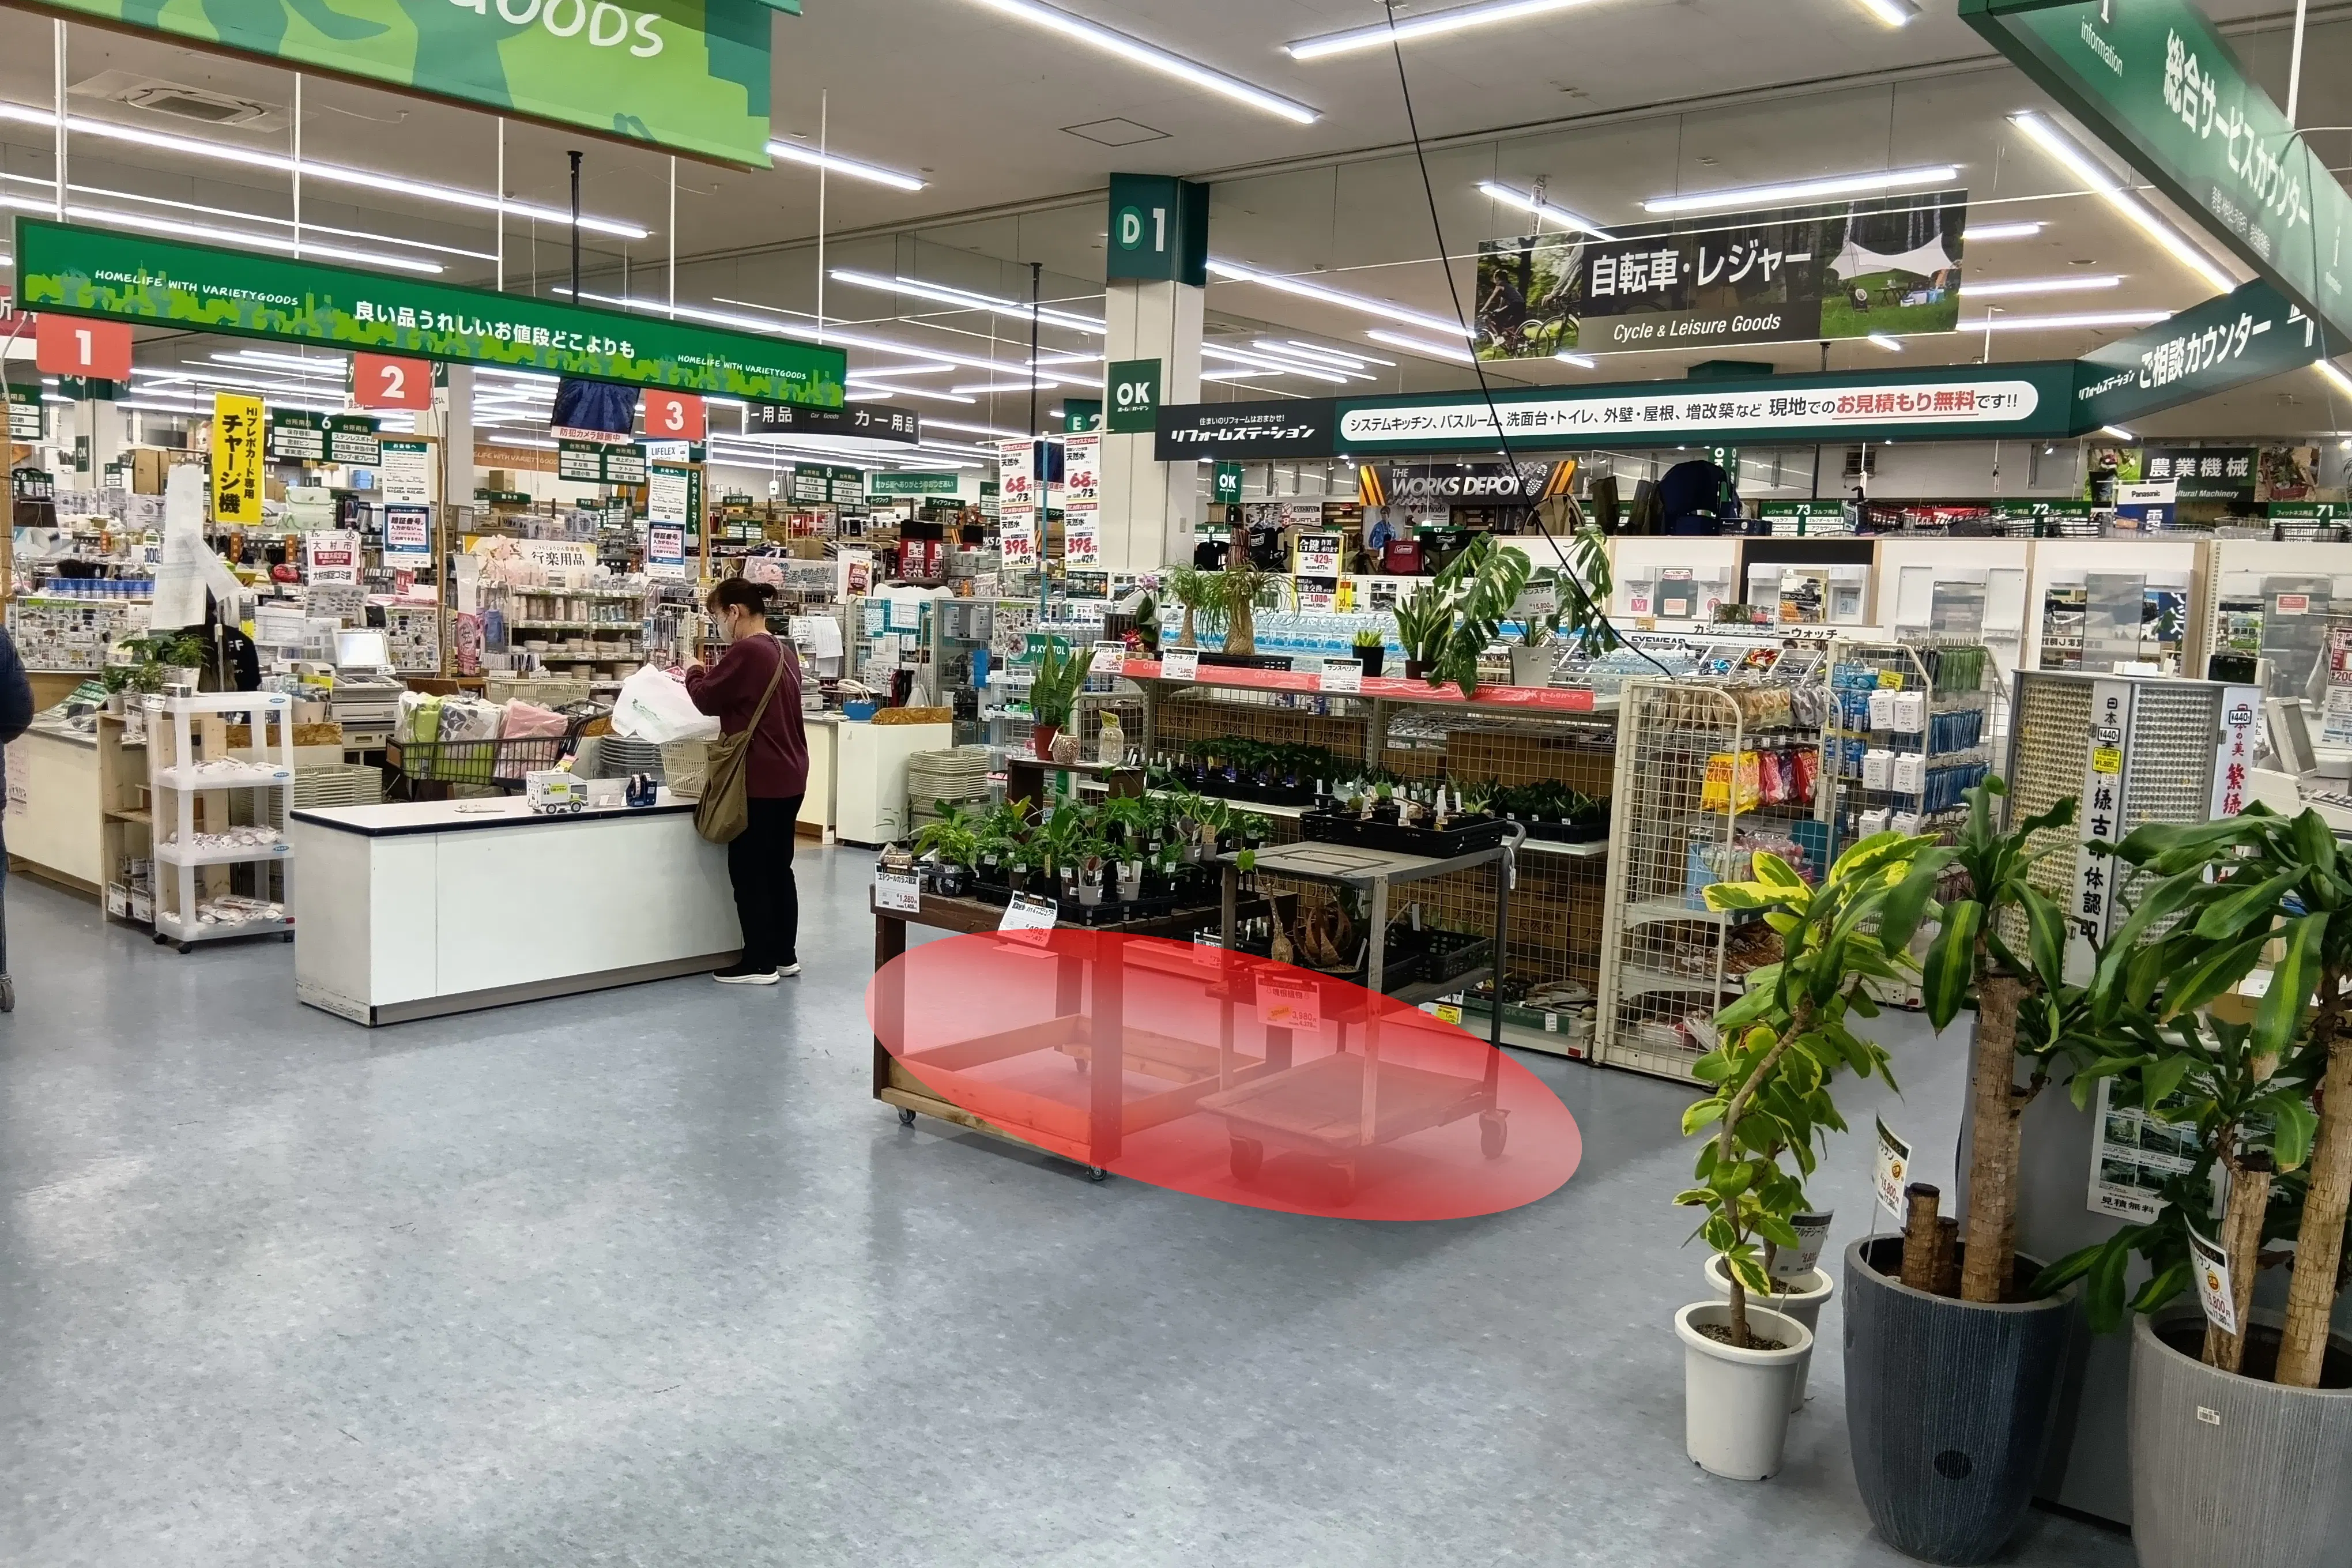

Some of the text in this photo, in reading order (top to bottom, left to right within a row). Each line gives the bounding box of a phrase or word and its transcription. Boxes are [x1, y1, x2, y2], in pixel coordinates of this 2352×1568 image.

[448, 0, 664, 58] OODS
[2081, 15, 2123, 77] information
[2163, 27, 2310, 229] 総合サービスカウンター
[1122, 208, 1165, 252] D 1
[1591, 238, 1811, 298] 自転車・レジャー
[95, 269, 299, 306] HOMELIFE WITH VARIETYGOODS
[355, 301, 635, 359] 良い品うれしいお値段どこよりも
[1614, 313, 1781, 341] Cycle & Leisure Goods
[76, 329, 91, 365] 1
[2139, 312, 2271, 389] ご相談カウンター
[678, 354, 806, 380] HOMELIFE WITH VARIETYGOODS
[380, 365, 405, 399] 2
[1117, 382, 1150, 405] OK
[322, 417, 332, 429] 6
[665, 401, 684, 431] 3
[855, 410, 913, 434] カー用品
[1171, 425, 1316, 443] リフォームステーション
[219, 414, 243, 515] チャージ機
[826, 467, 832, 478] 8
[1392, 469, 1409, 477] THE
[2149, 457, 2248, 477] 農業機械
[1219, 474, 1237, 489] OK
[1392, 477, 1461, 496] WORKS
[2131, 489, 2161, 499] Panasonic
[2199, 489, 2239, 501] Machinery
[1796, 504, 1811, 515] 73
[2032, 504, 2049, 515] 72
[2316, 505, 2334, 517] 71
[532, 551, 585, 566] 行楽用品
